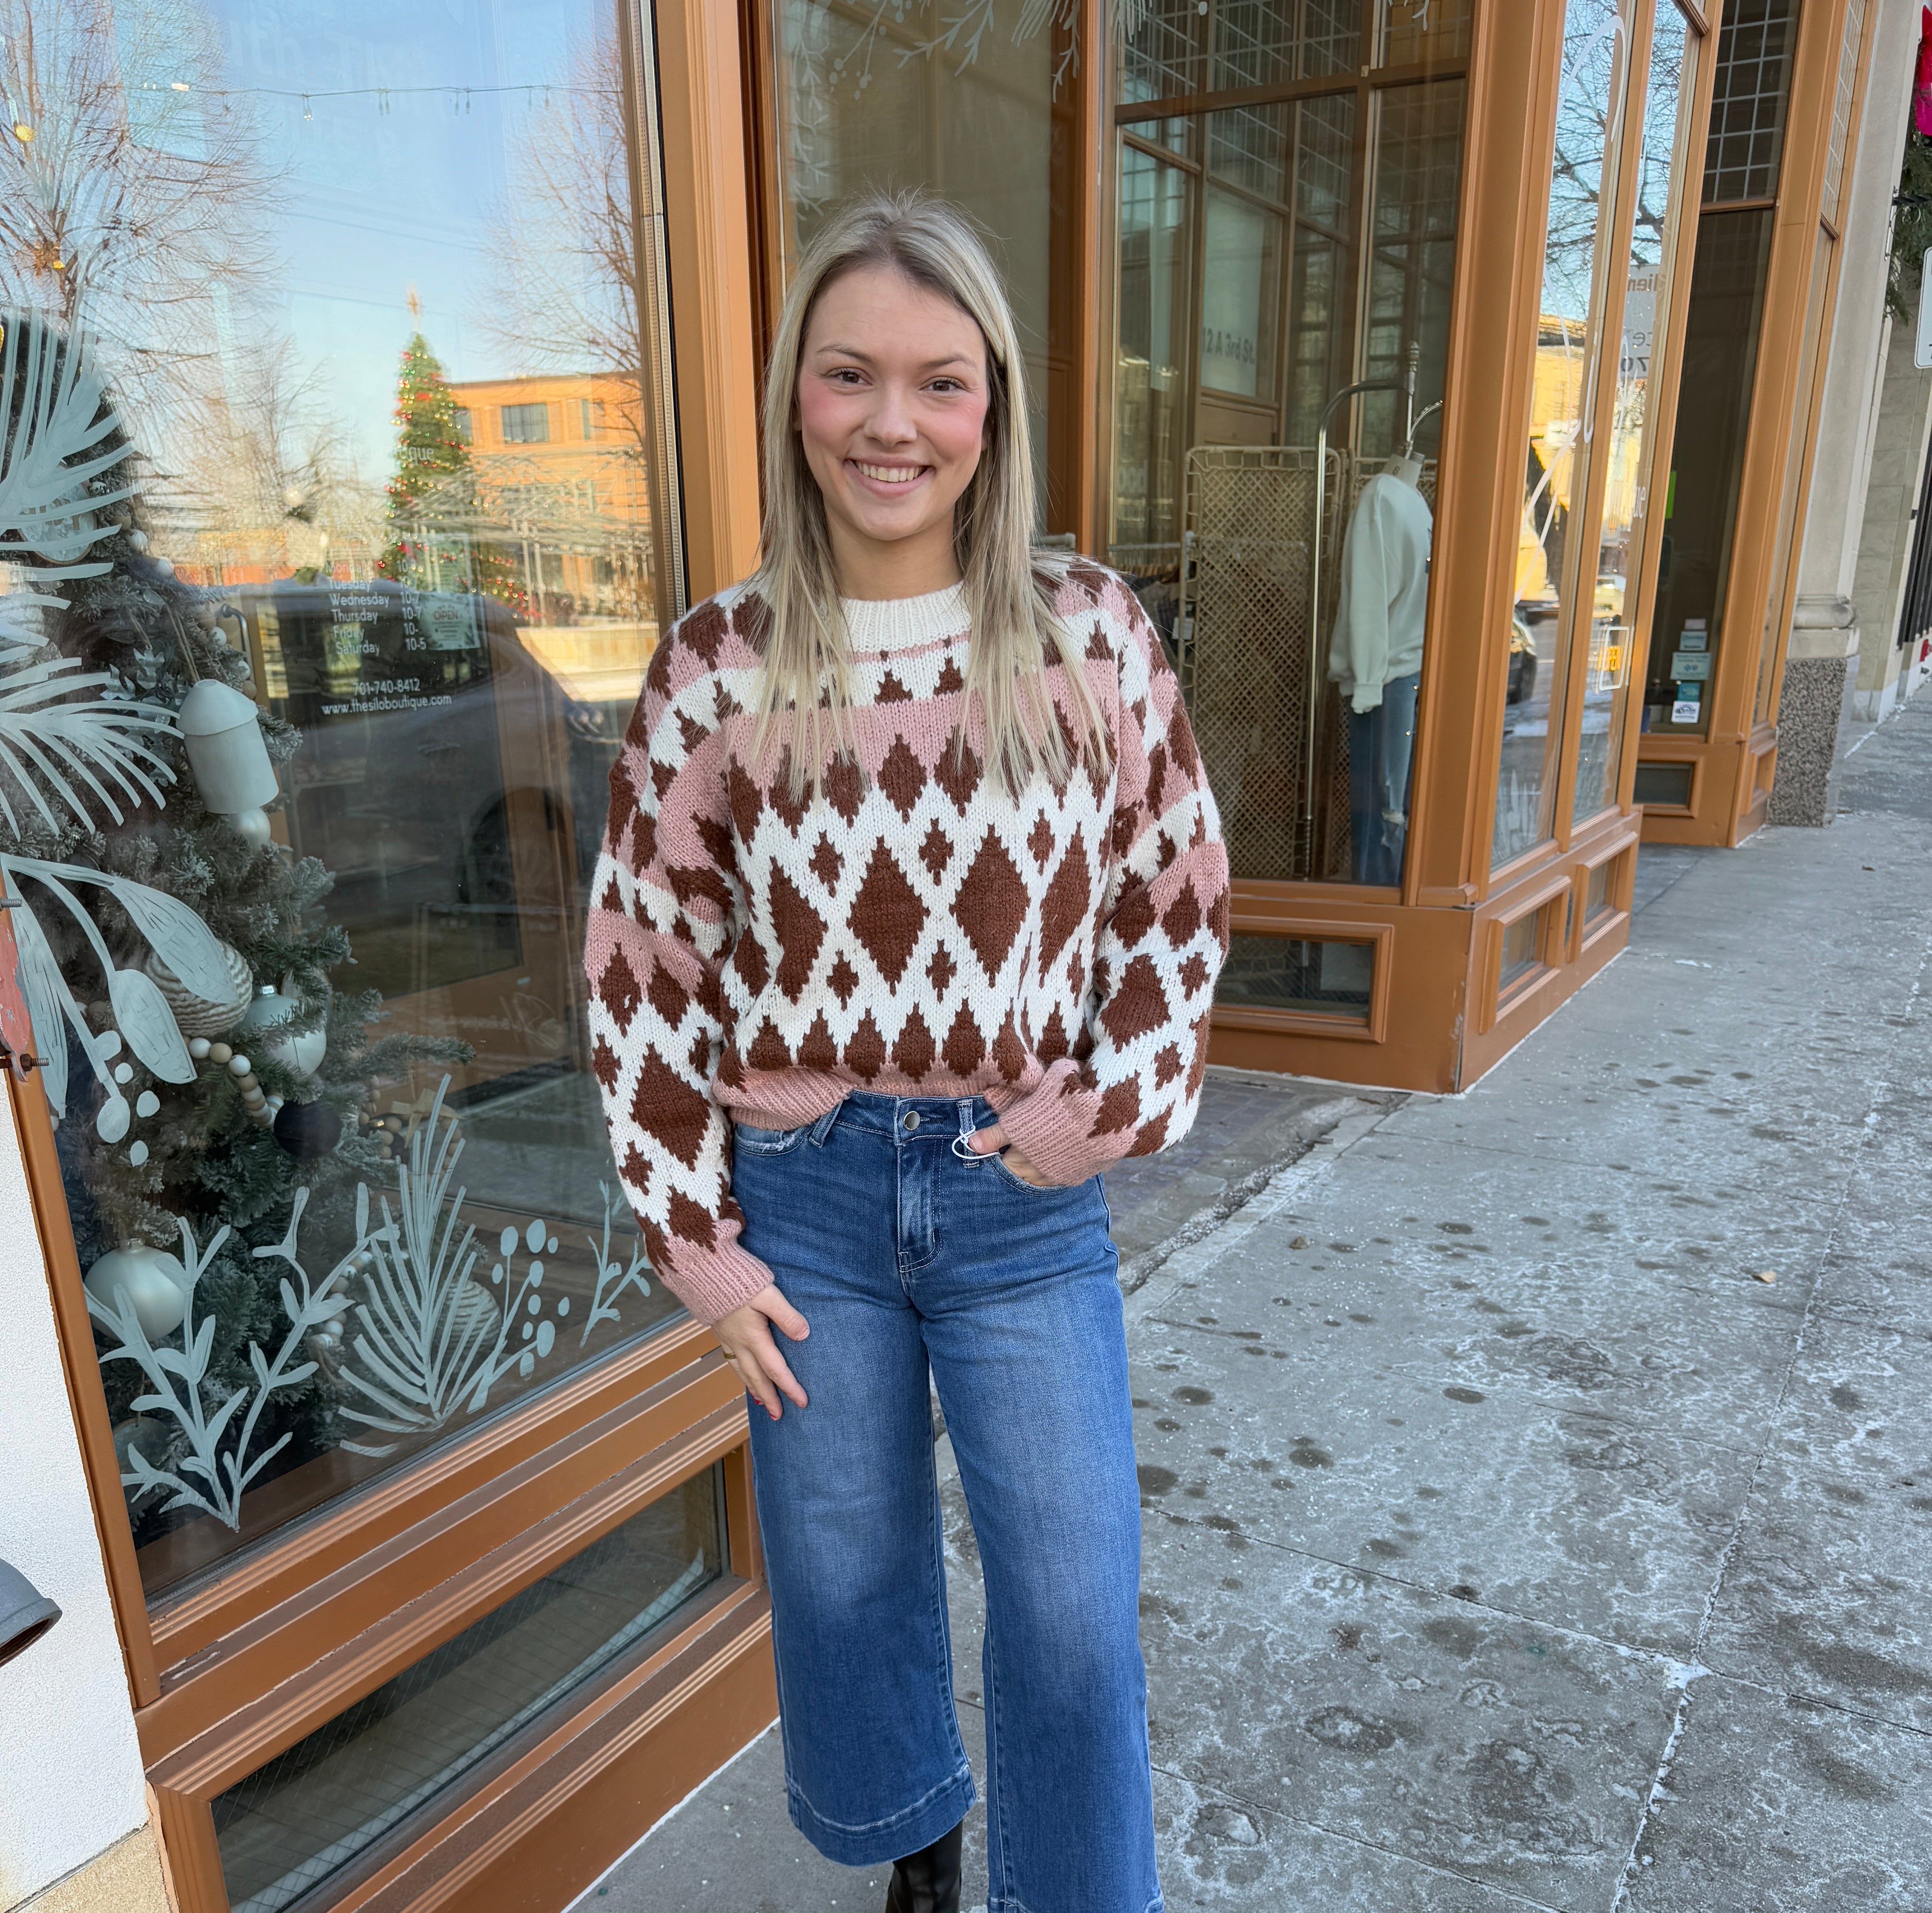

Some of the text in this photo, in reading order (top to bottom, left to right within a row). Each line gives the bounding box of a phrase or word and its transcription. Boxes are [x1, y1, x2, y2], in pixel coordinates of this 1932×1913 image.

[326, 561, 373, 577] Monday
[330, 579, 372, 592] Tuesday
[329, 591, 420, 608] Wednesday 10-7
[331, 607, 378, 625] Thursday
[401, 606, 422, 621] 10-7
[333, 625, 365, 641] Friday
[335, 637, 427, 657] Saturday 10-5
[352, 677, 421, 696] 701-740-8412
[321, 694, 453, 716] www.thesiloboutique.com
